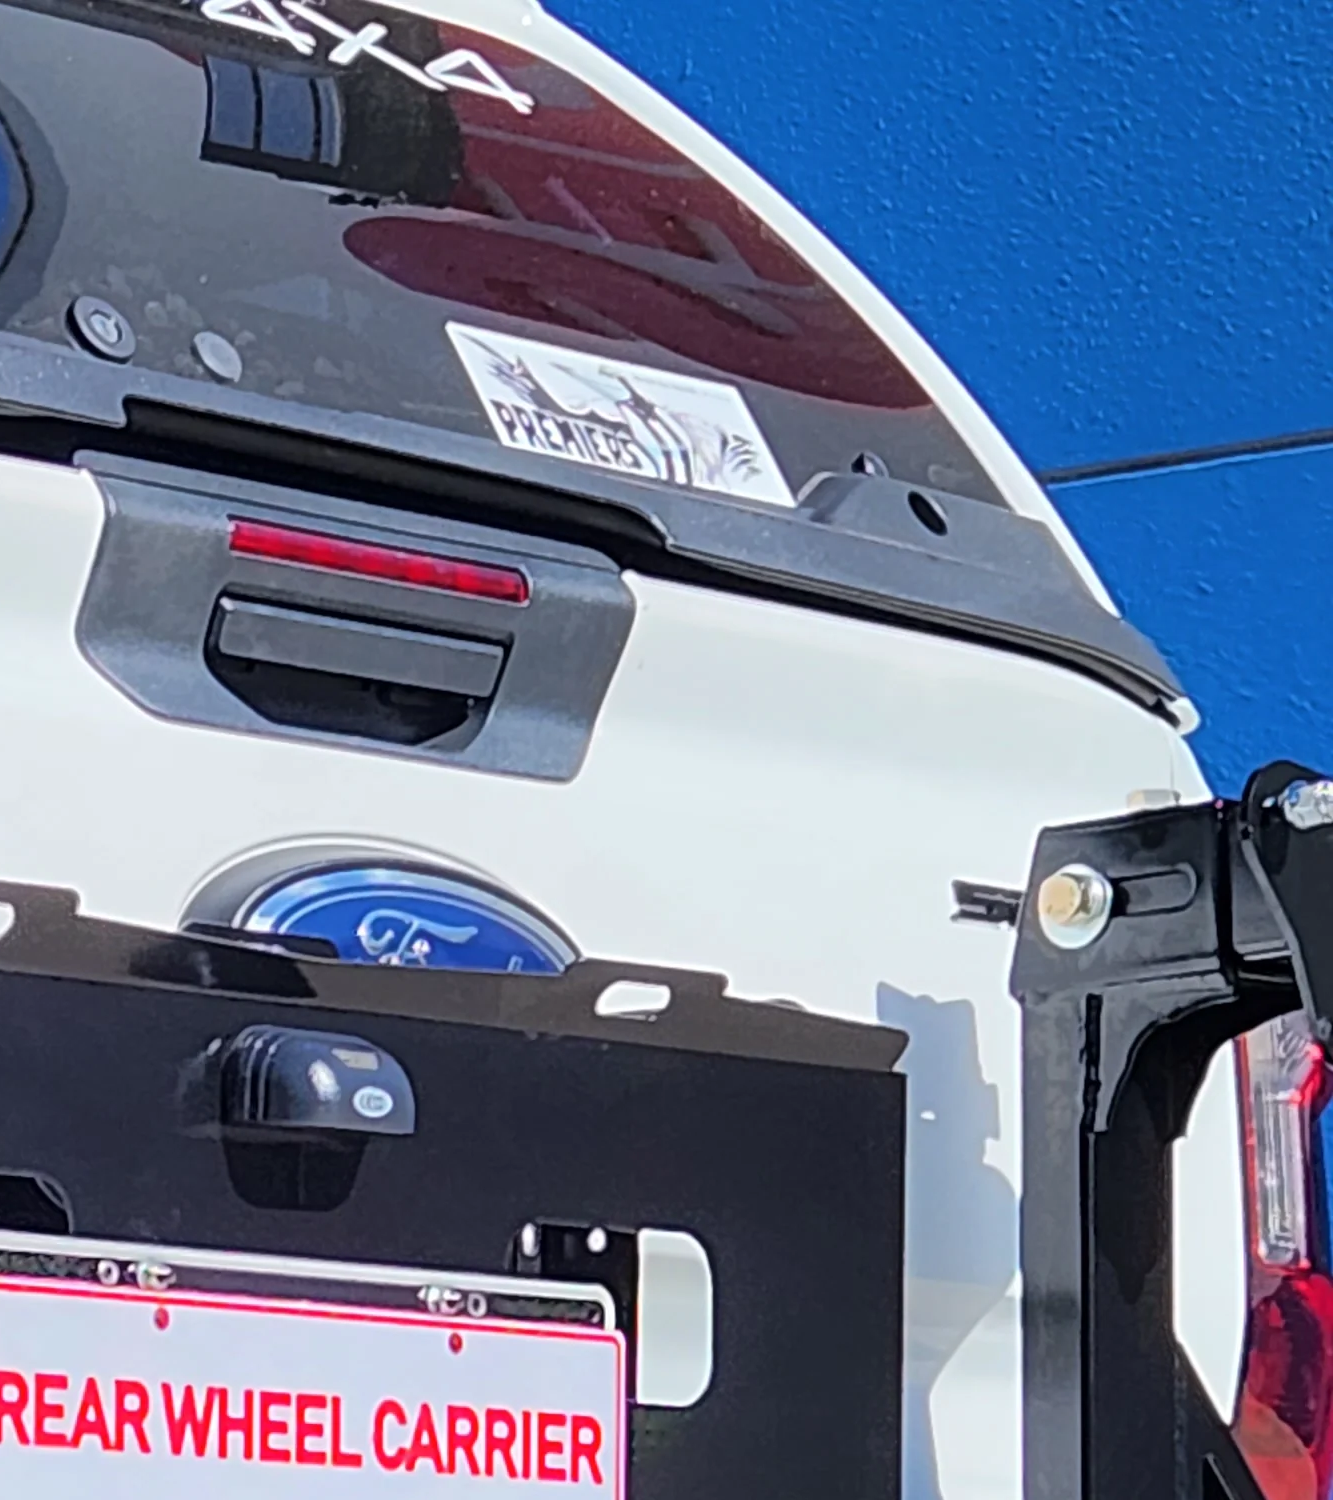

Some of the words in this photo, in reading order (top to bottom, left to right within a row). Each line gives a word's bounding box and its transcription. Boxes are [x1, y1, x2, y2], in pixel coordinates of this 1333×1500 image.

[488, 398, 646, 471] PREMIERS
[161, 1381, 362, 1468] WHEEL
[372, 1399, 604, 1485] CARRIER
